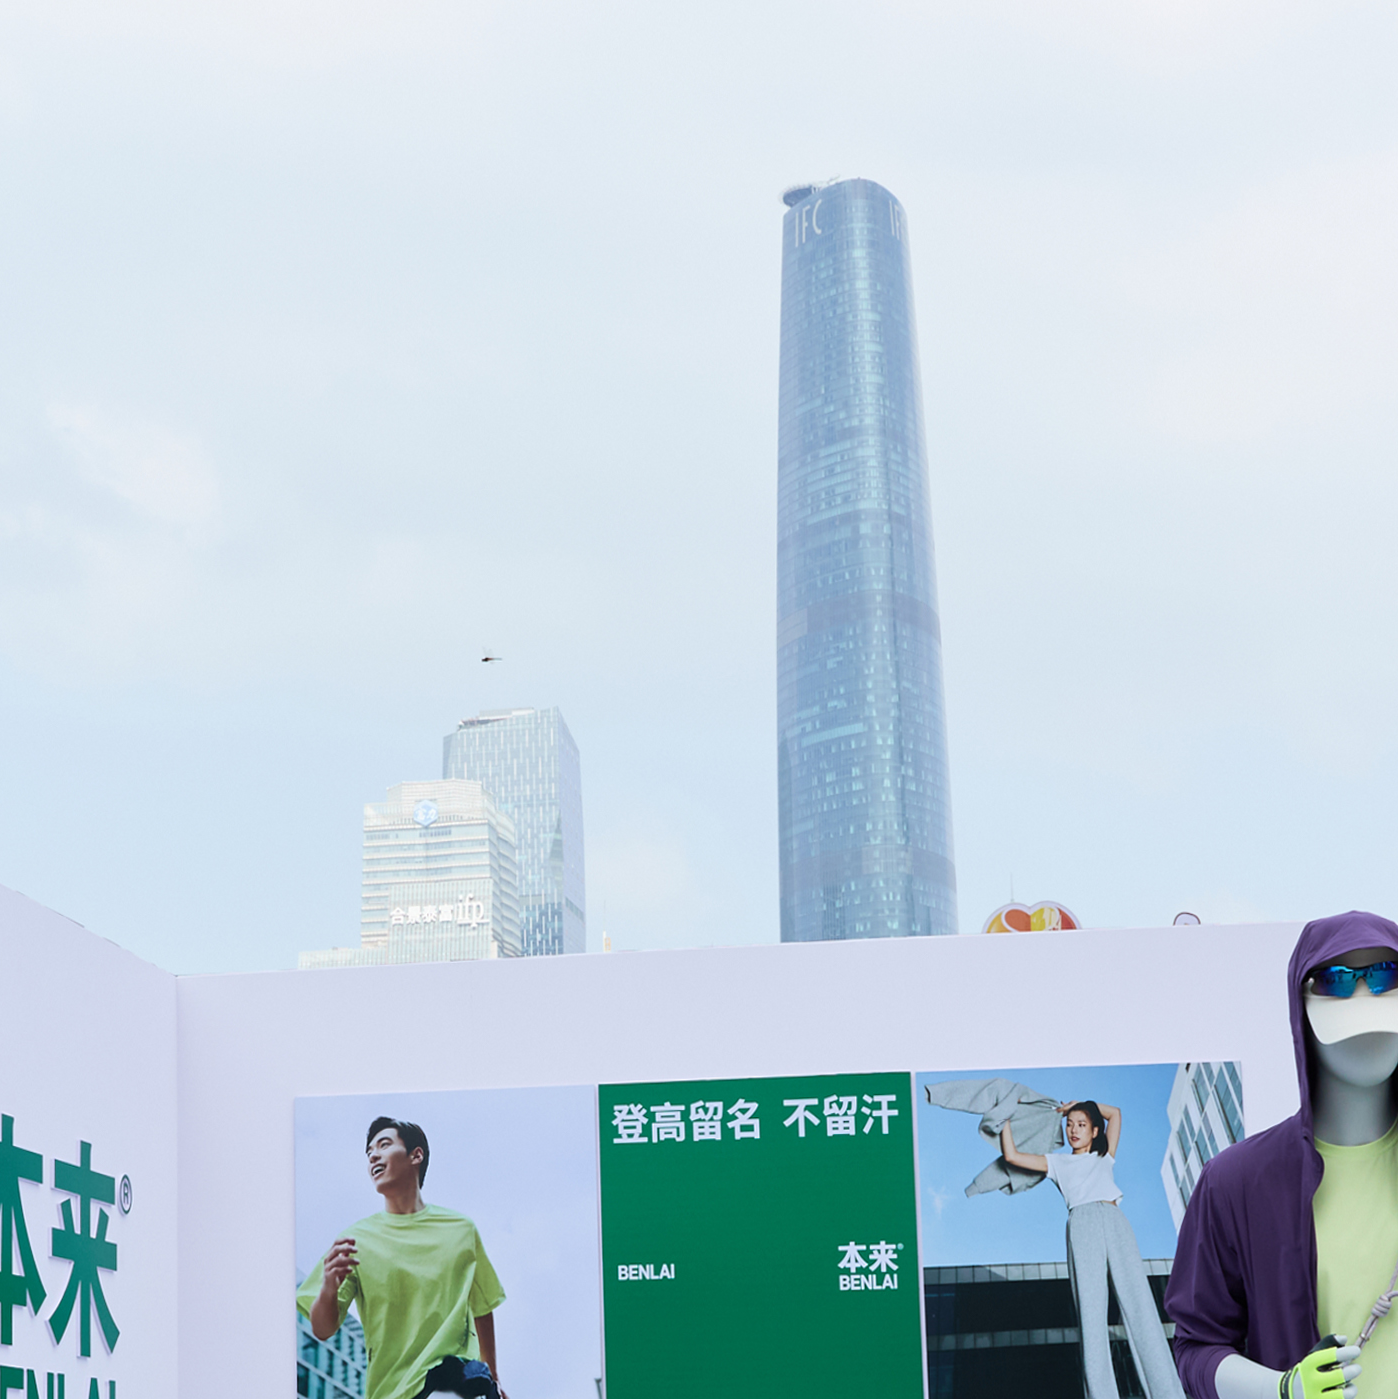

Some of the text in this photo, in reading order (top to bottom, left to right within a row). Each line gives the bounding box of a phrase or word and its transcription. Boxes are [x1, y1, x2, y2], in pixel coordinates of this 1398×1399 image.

[795, 199, 822, 248] IFC
[611, 1094, 899, 1144] 登高留名 不留汗
[617, 1263, 675, 1280] BENLAI
[839, 1274, 898, 1291] BENLAI
